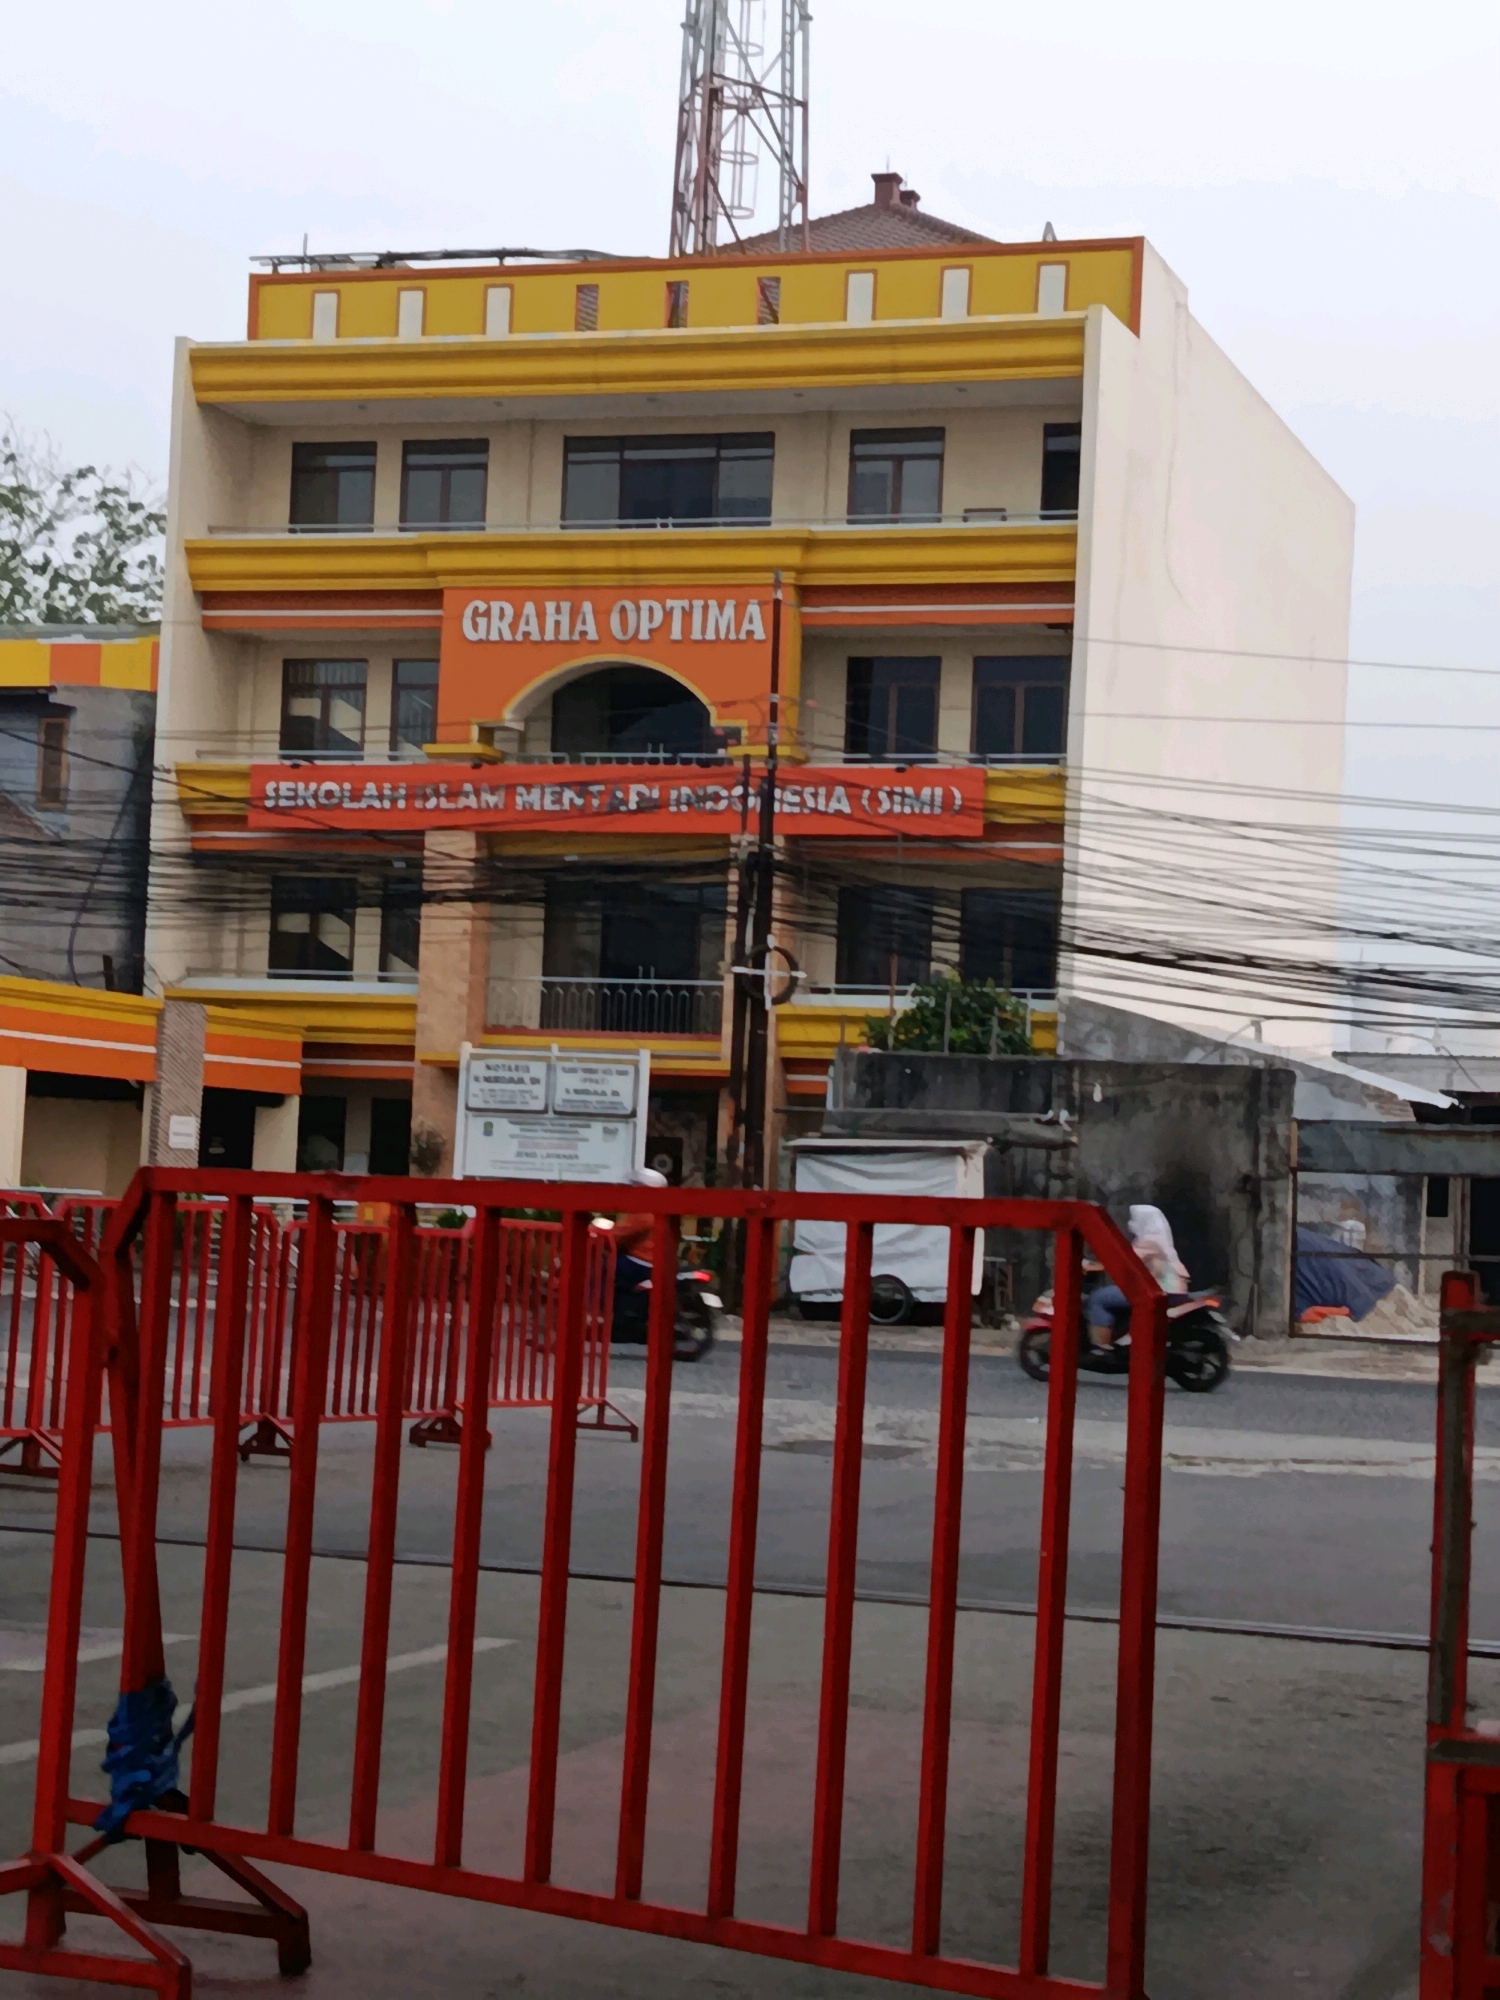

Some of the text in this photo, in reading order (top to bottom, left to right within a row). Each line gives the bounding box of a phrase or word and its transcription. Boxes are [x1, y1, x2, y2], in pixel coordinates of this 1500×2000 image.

[461, 598, 766, 642] GRAHA OPTIMA
[263, 780, 407, 810] SEKOLAH
